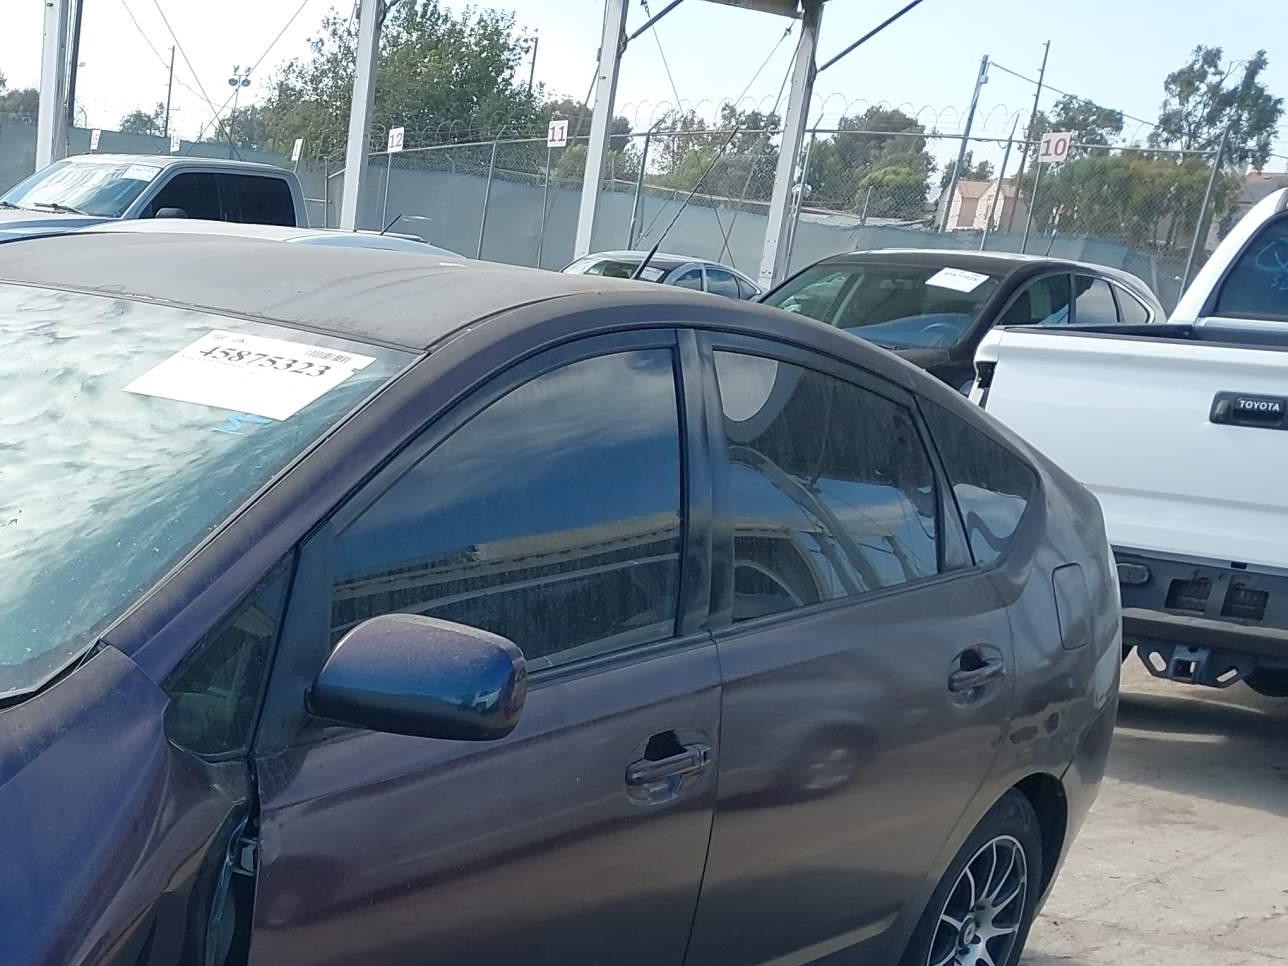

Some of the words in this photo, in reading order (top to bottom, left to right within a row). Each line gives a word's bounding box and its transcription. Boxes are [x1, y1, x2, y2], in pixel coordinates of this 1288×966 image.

[389, 132, 403, 148] 12
[549, 125, 566, 142] 11
[1040, 138, 1067, 156] 10
[200, 345, 332, 377] 45875323
[1239, 400, 1280, 412] TOYOTA
